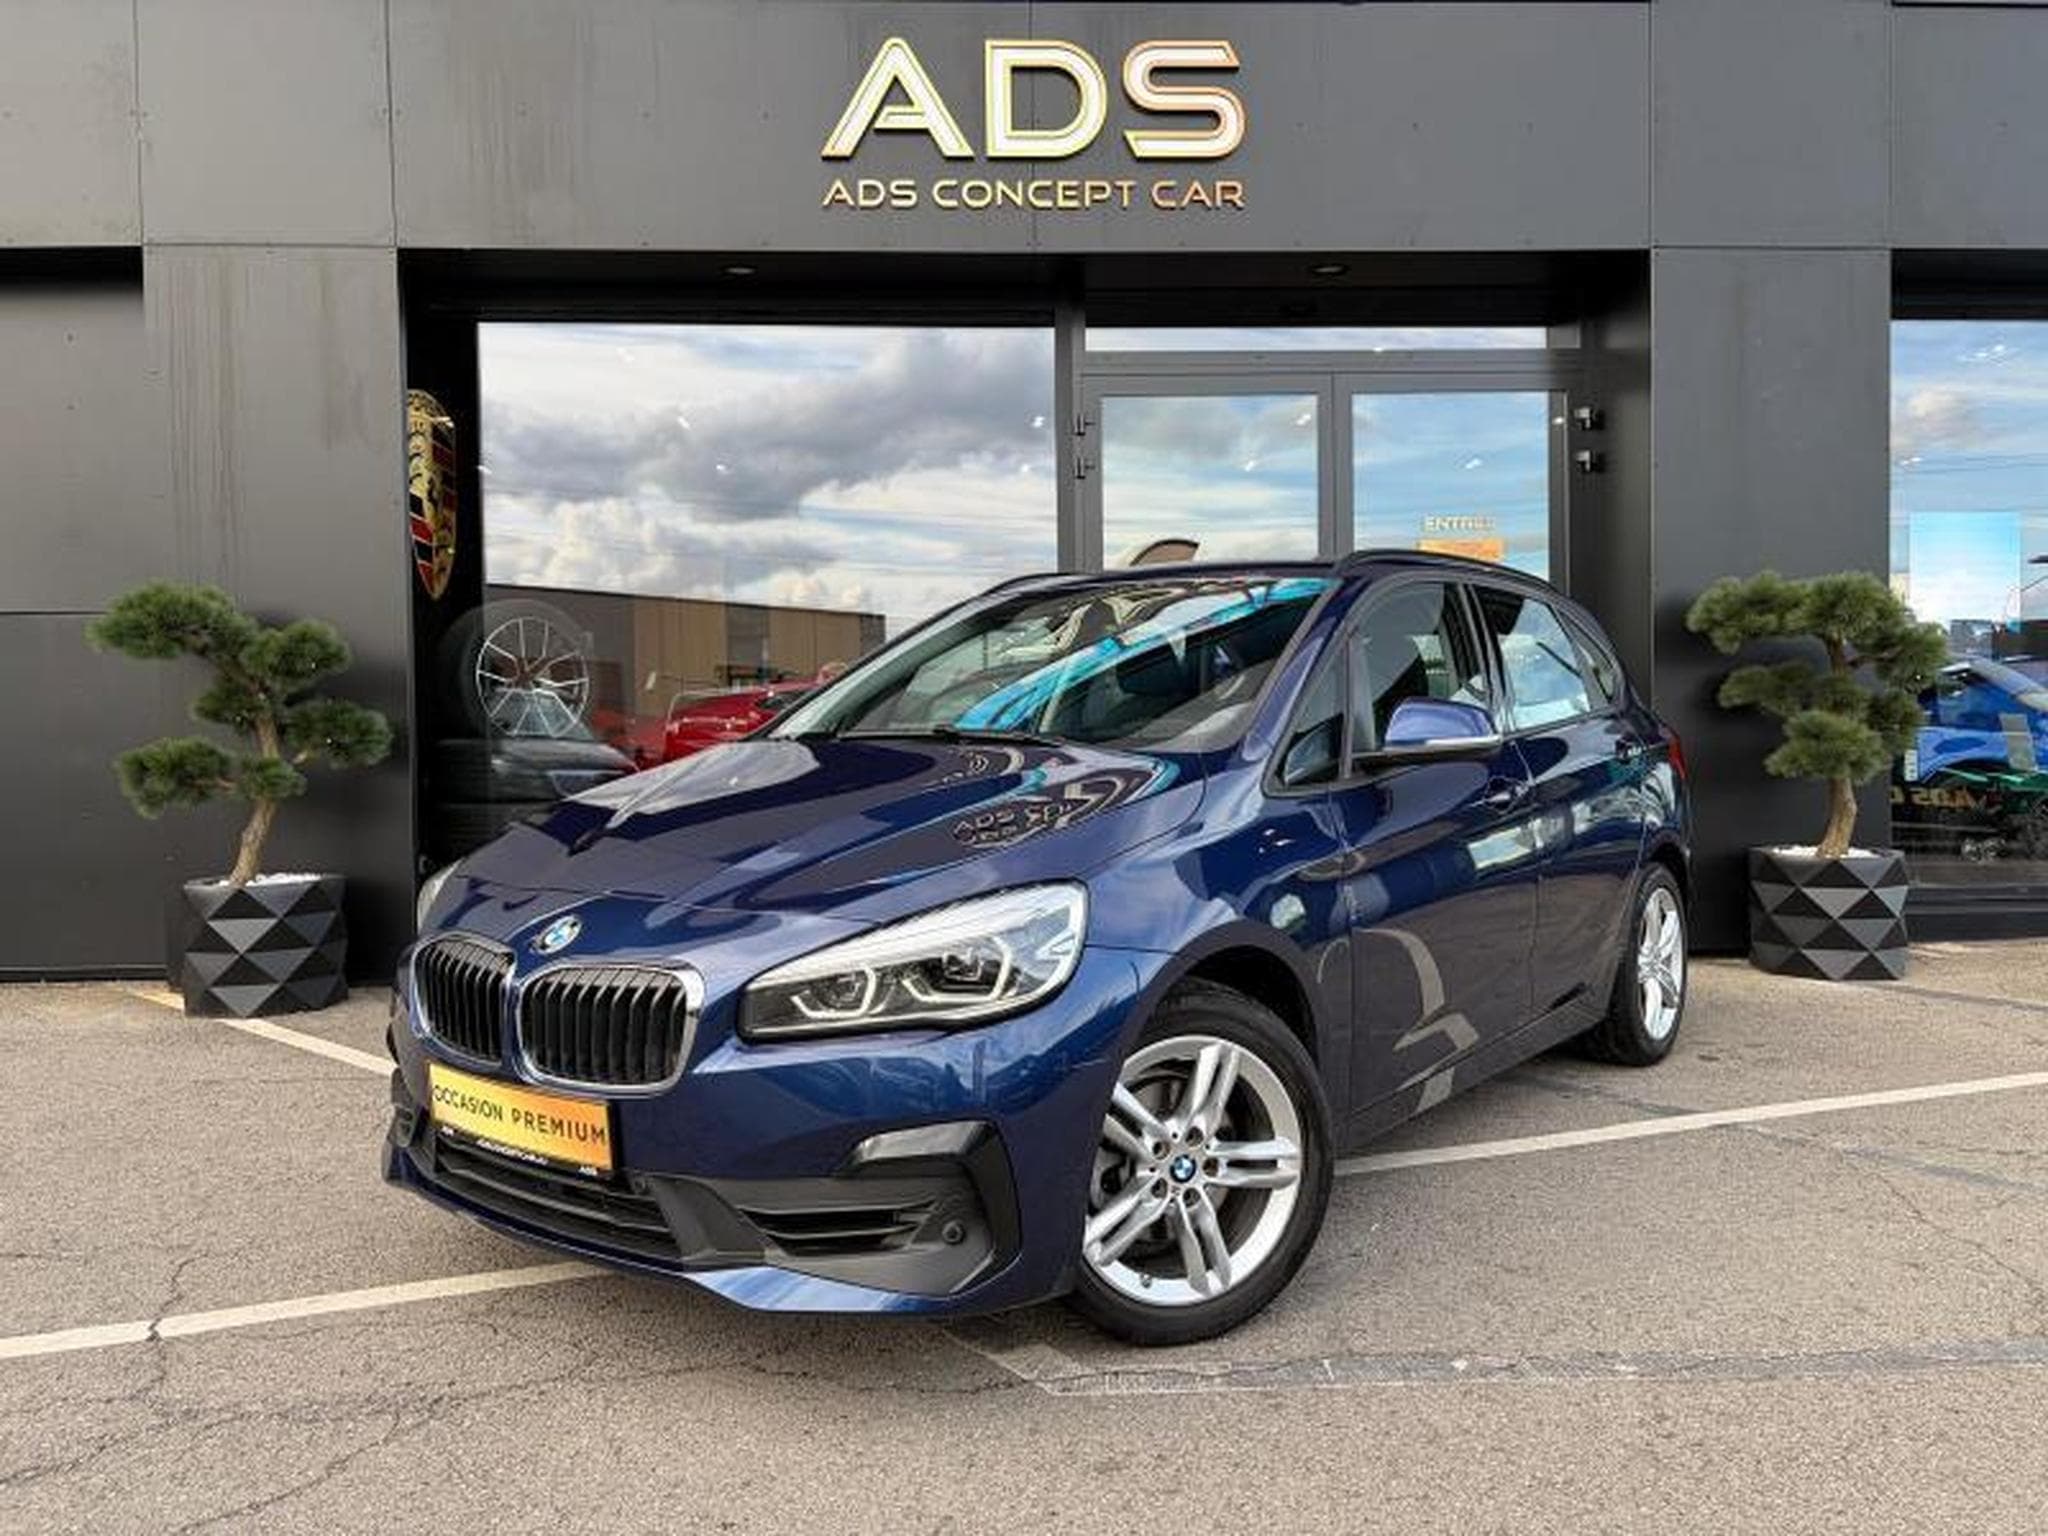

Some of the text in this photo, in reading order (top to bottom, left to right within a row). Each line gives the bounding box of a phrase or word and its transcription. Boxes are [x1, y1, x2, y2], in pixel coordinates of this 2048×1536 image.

[821, 37, 1246, 159] ADS
[823, 179, 1245, 207] ADS CONCEPT CAR
[430, 1084, 608, 1145] OCCASION PREMIUM
